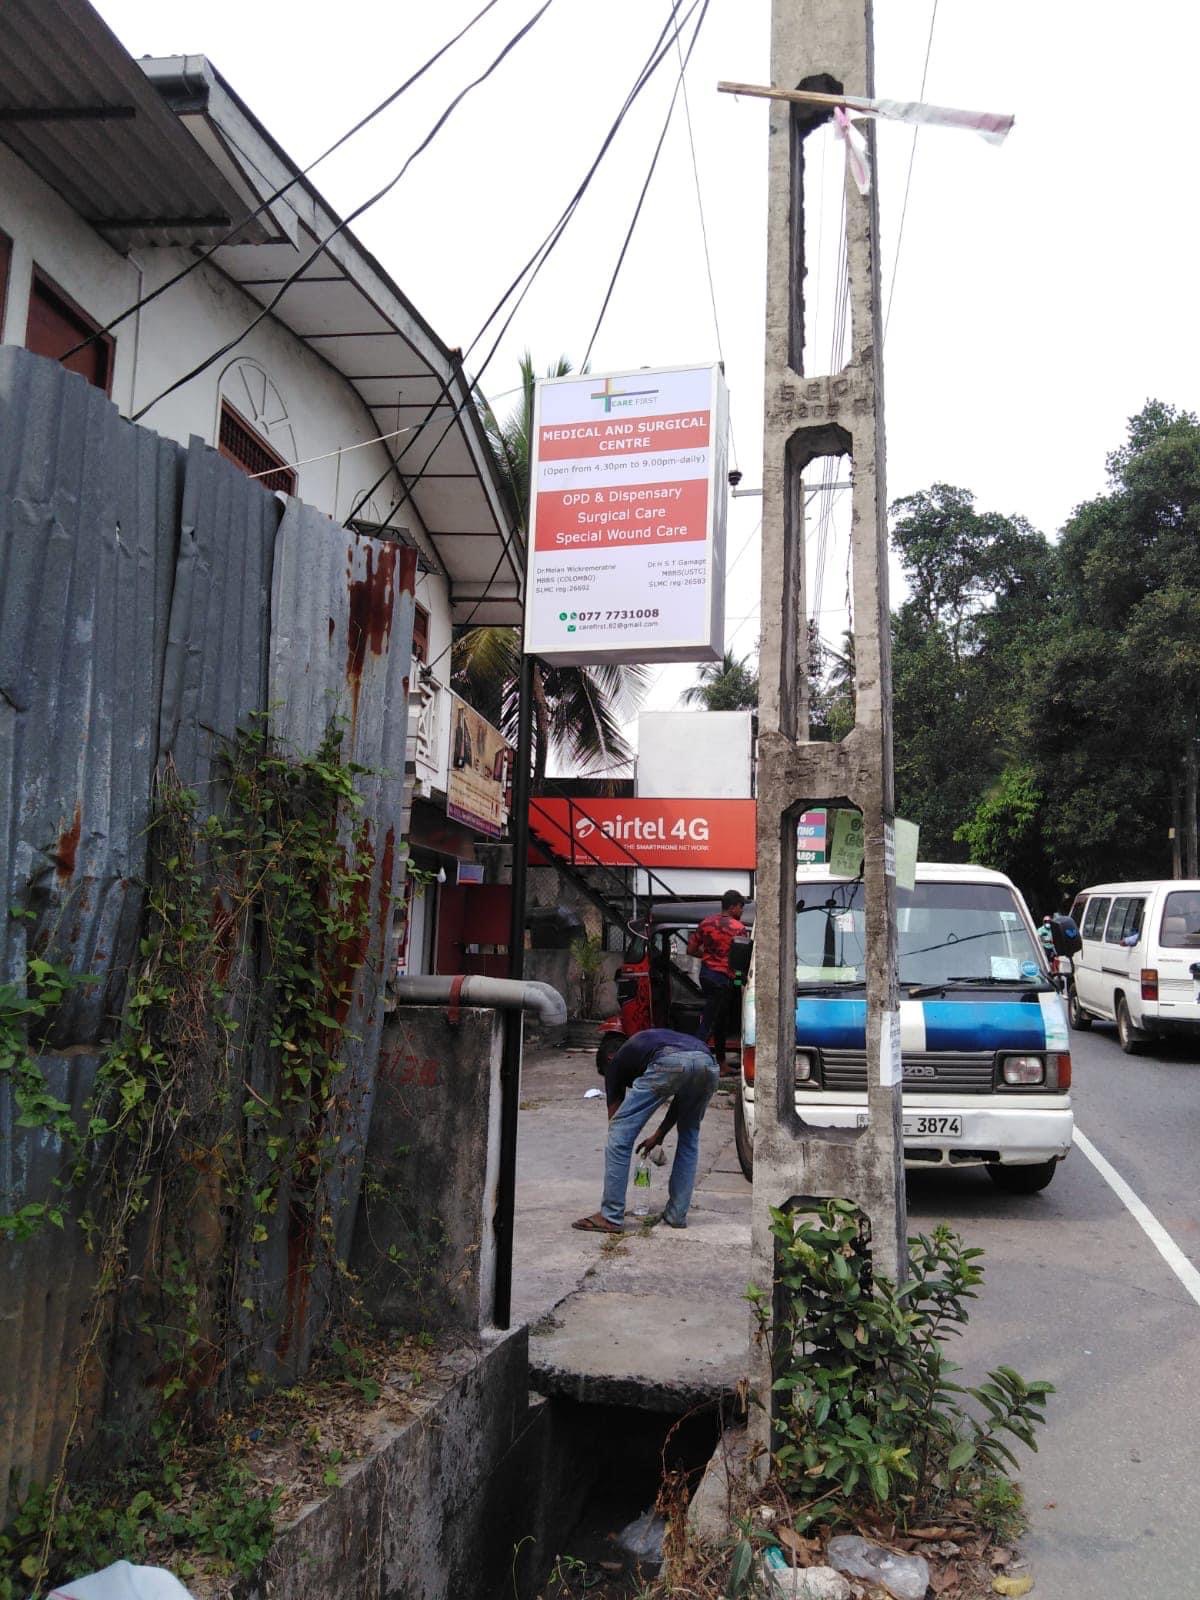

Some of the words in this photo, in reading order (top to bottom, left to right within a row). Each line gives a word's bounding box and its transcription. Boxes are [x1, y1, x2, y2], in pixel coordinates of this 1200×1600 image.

[612, 399, 633, 407] CARE
[635, 397, 657, 406] FIRST
[543, 427, 600, 441] MEDICAL
[605, 424, 633, 436] AND
[638, 417, 707, 433] SURGICAL
[599, 437, 650, 450] CENTRE
[543, 464, 569, 476] (Open
[571, 464, 592, 473] from
[594, 462, 627, 473] 4.30pm
[563, 493, 590, 505] OPD
[594, 492, 604, 503] &
[609, 487, 682, 503] Dispensary
[578, 509, 630, 524] Surgical
[635, 507, 666, 519] Care
[556, 531, 602, 544] Special
[607, 527, 651, 541] Wound
[656, 525, 688, 537] Care
[557, 574, 596, 584] (COLOMBO)
[579, 612, 601, 621] 077
[606, 608, 659, 621] 7731008
[600, 814, 666, 839] airtel
[670, 818, 709, 840] 4G
[917, 1117, 959, 1134] 3874
